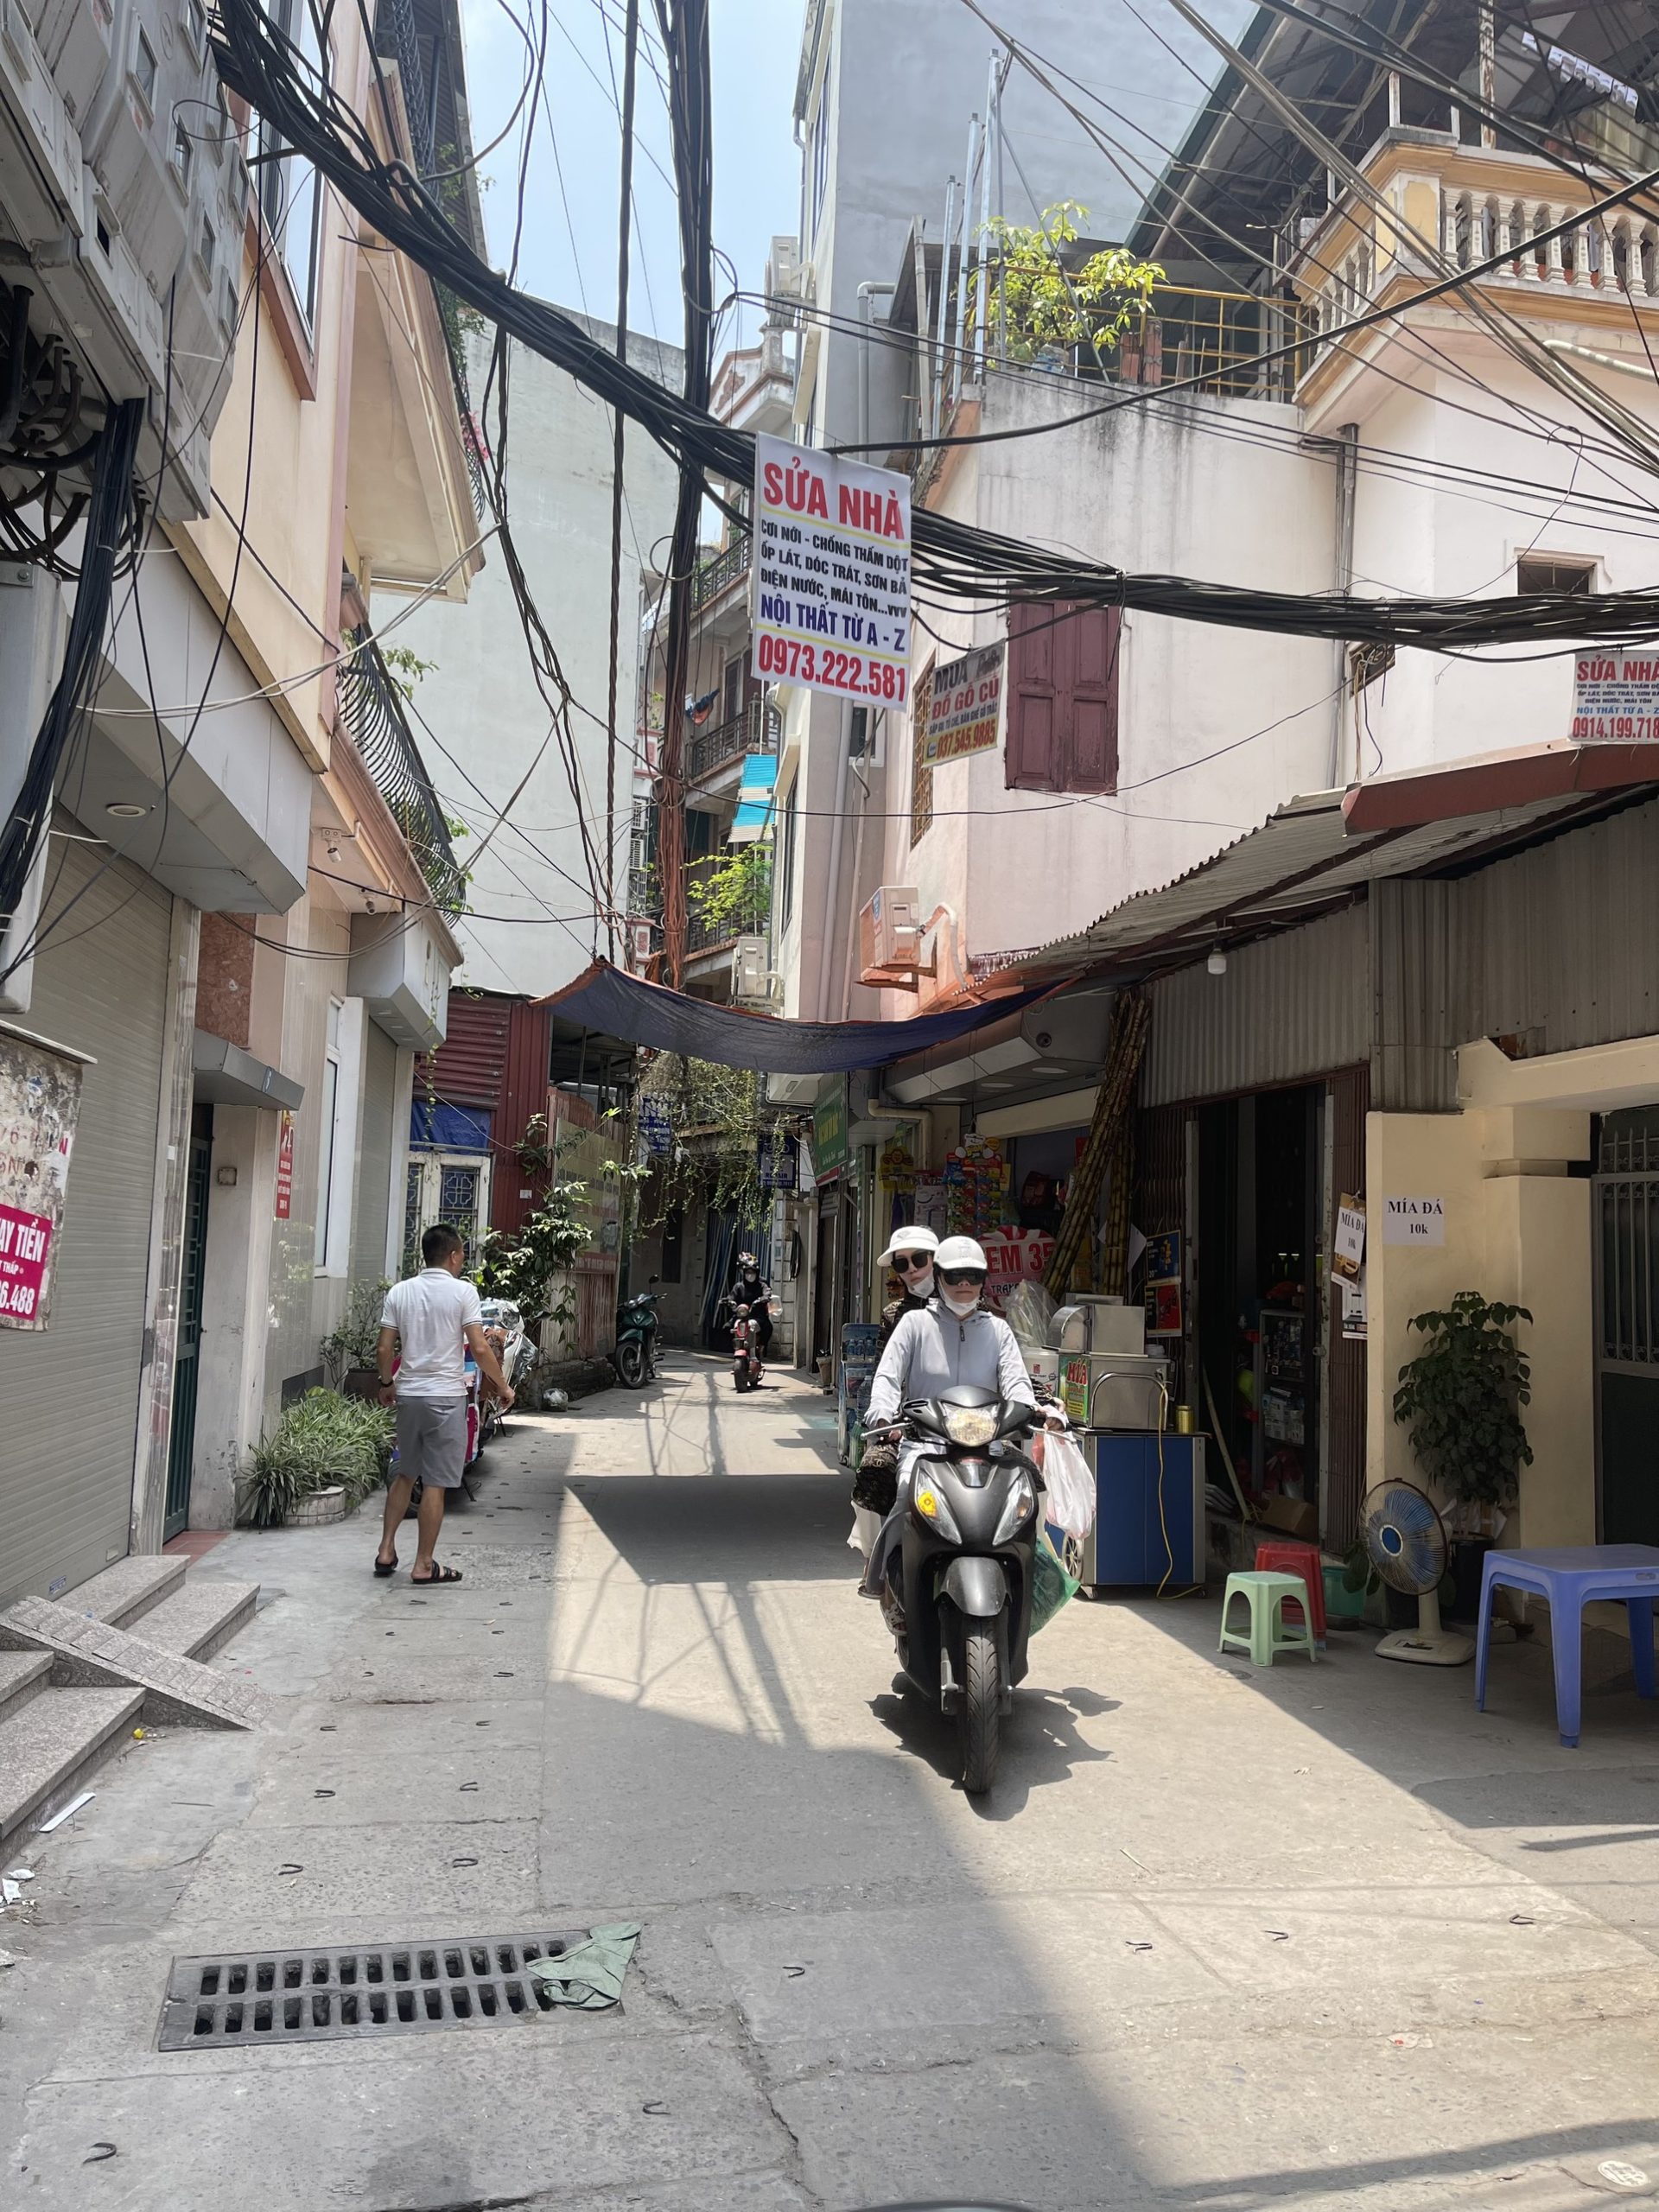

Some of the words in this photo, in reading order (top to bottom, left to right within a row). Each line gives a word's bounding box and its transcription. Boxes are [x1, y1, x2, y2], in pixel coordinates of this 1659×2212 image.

[764, 455, 829, 519] SỬA
[839, 484, 905, 540] NHÀ
[781, 524, 802, 544] NỚI
[812, 534, 851, 557] CHỐNG
[854, 545, 884, 568] THẤM
[761, 540, 775, 561] ỐP
[779, 549, 802, 570] LÁT,
[832, 563, 861, 586] TRÁT,
[864, 572, 887, 592] SƠN
[760, 568, 787, 590] ĐIỆN
[791, 573, 828, 601] NƯỚC,
[830, 586, 853, 606] MÁI
[761, 594, 791, 628] NỘI
[796, 601, 838, 636] THẤT
[842, 611, 864, 642] TỪ
[867, 622, 878, 646] A
[893, 628, 906, 652] Z
[758, 634, 906, 702] 0973.222.581
[934, 660, 968, 696] MUA
[1577, 654, 1616, 681] SỬA
[1573, 716, 1659, 739] 0914.199.718
[1341, 1211, 1354, 1229] MÍA
[1388, 1198, 1418, 1213] MÍA
[1422, 1198, 1443, 1214] ĐÁ
[0, 1217, 16, 1254] AY
[1410, 1224, 1428, 1234] 10k
[986, 1244, 1023, 1274] EM
[0, 1281, 35, 1315] 6.488
[1066, 1358, 1087, 1385] MÍA
